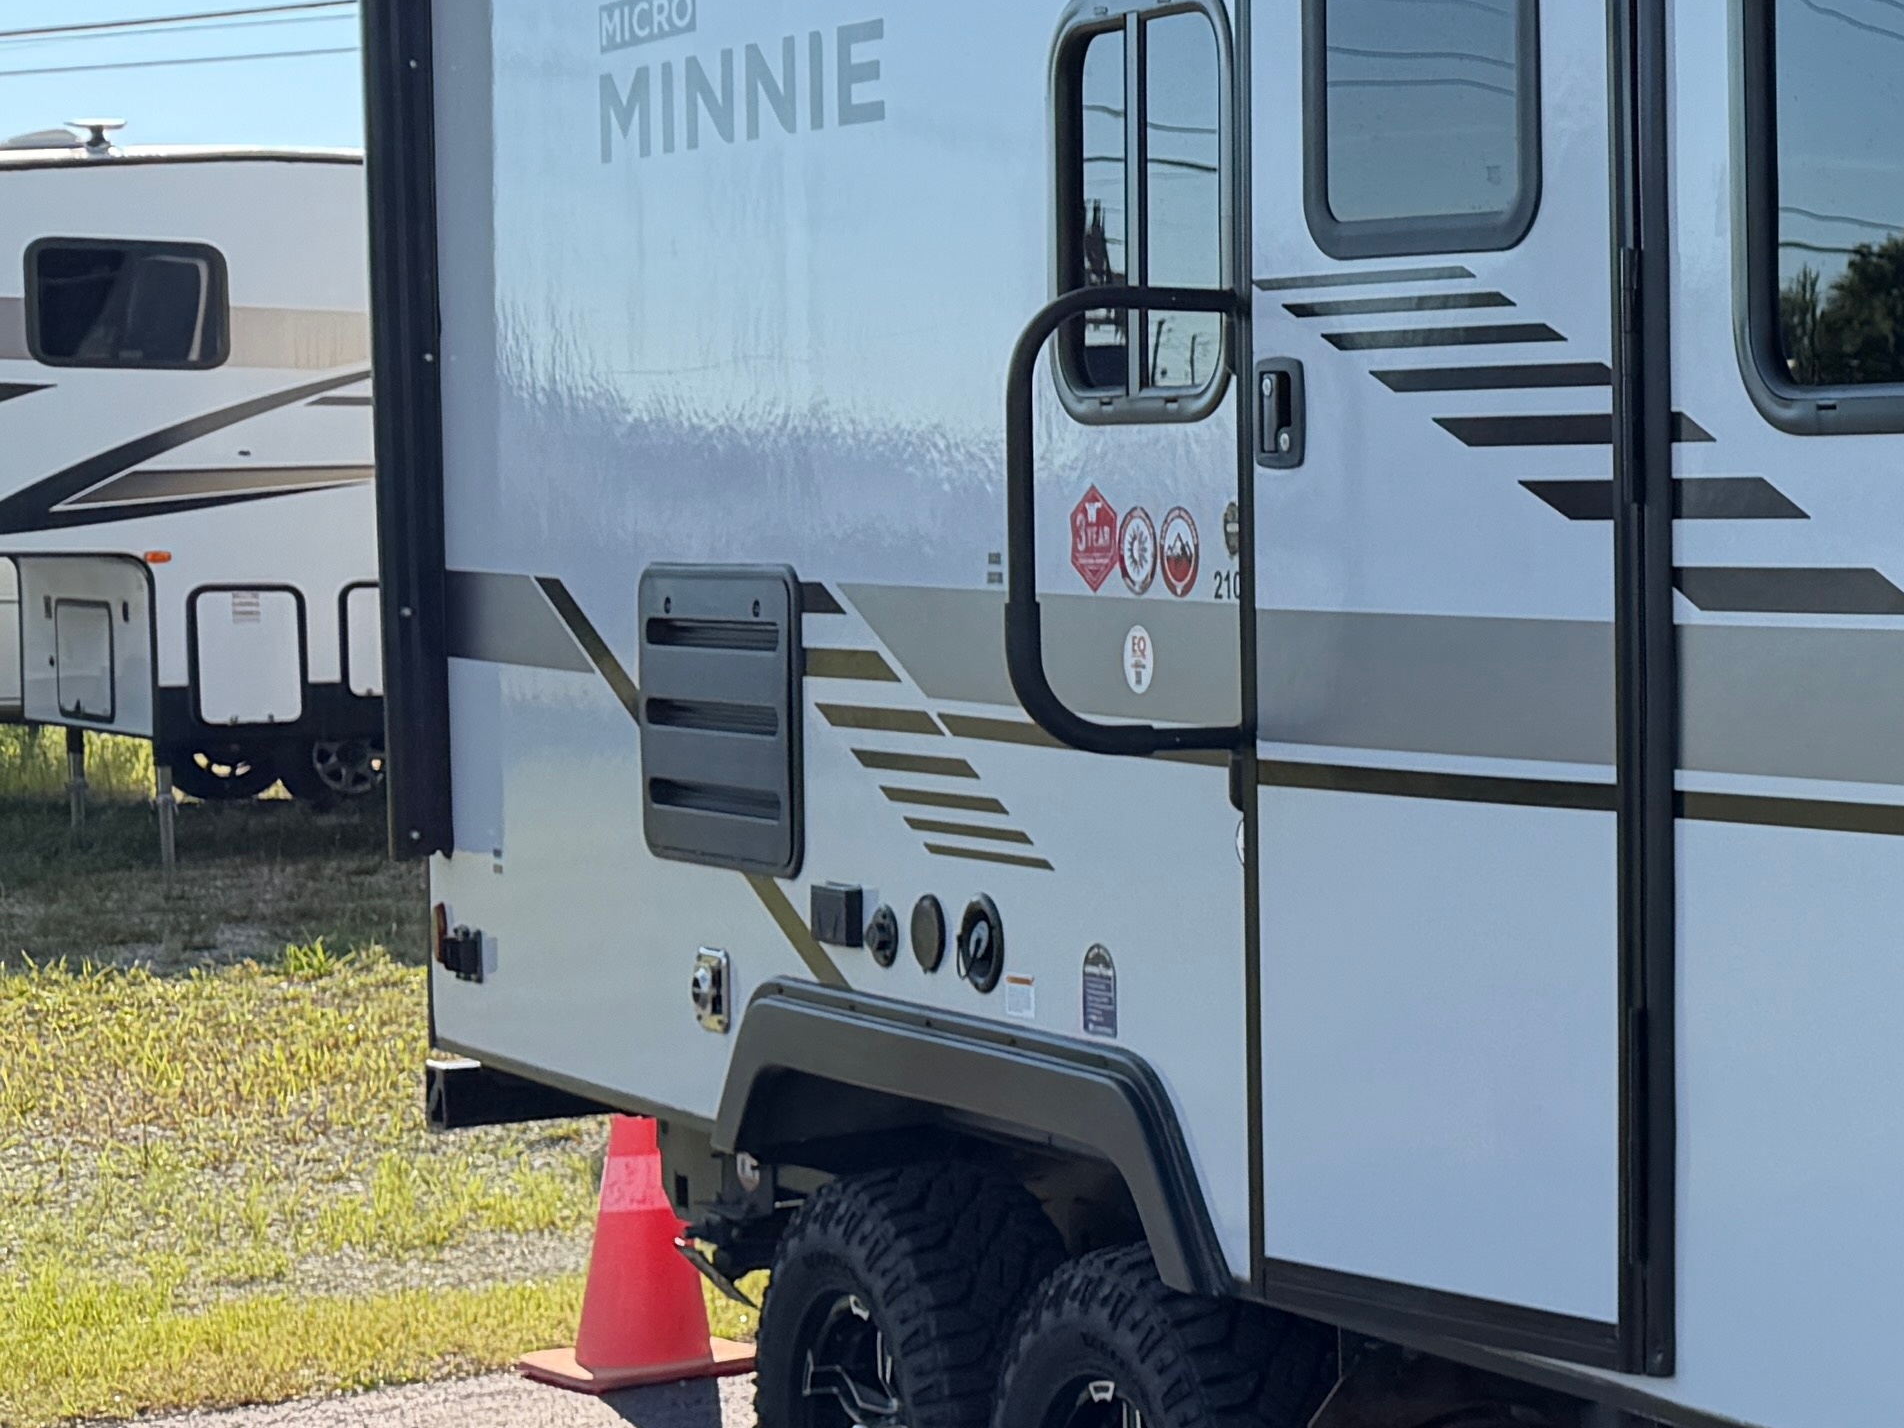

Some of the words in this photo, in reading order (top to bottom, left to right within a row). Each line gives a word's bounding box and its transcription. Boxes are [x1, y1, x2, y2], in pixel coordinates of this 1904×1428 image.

[599, 17, 886, 164] MINNIE
[1076, 513, 1086, 552] 3
[1086, 526, 1111, 549] YEAR
